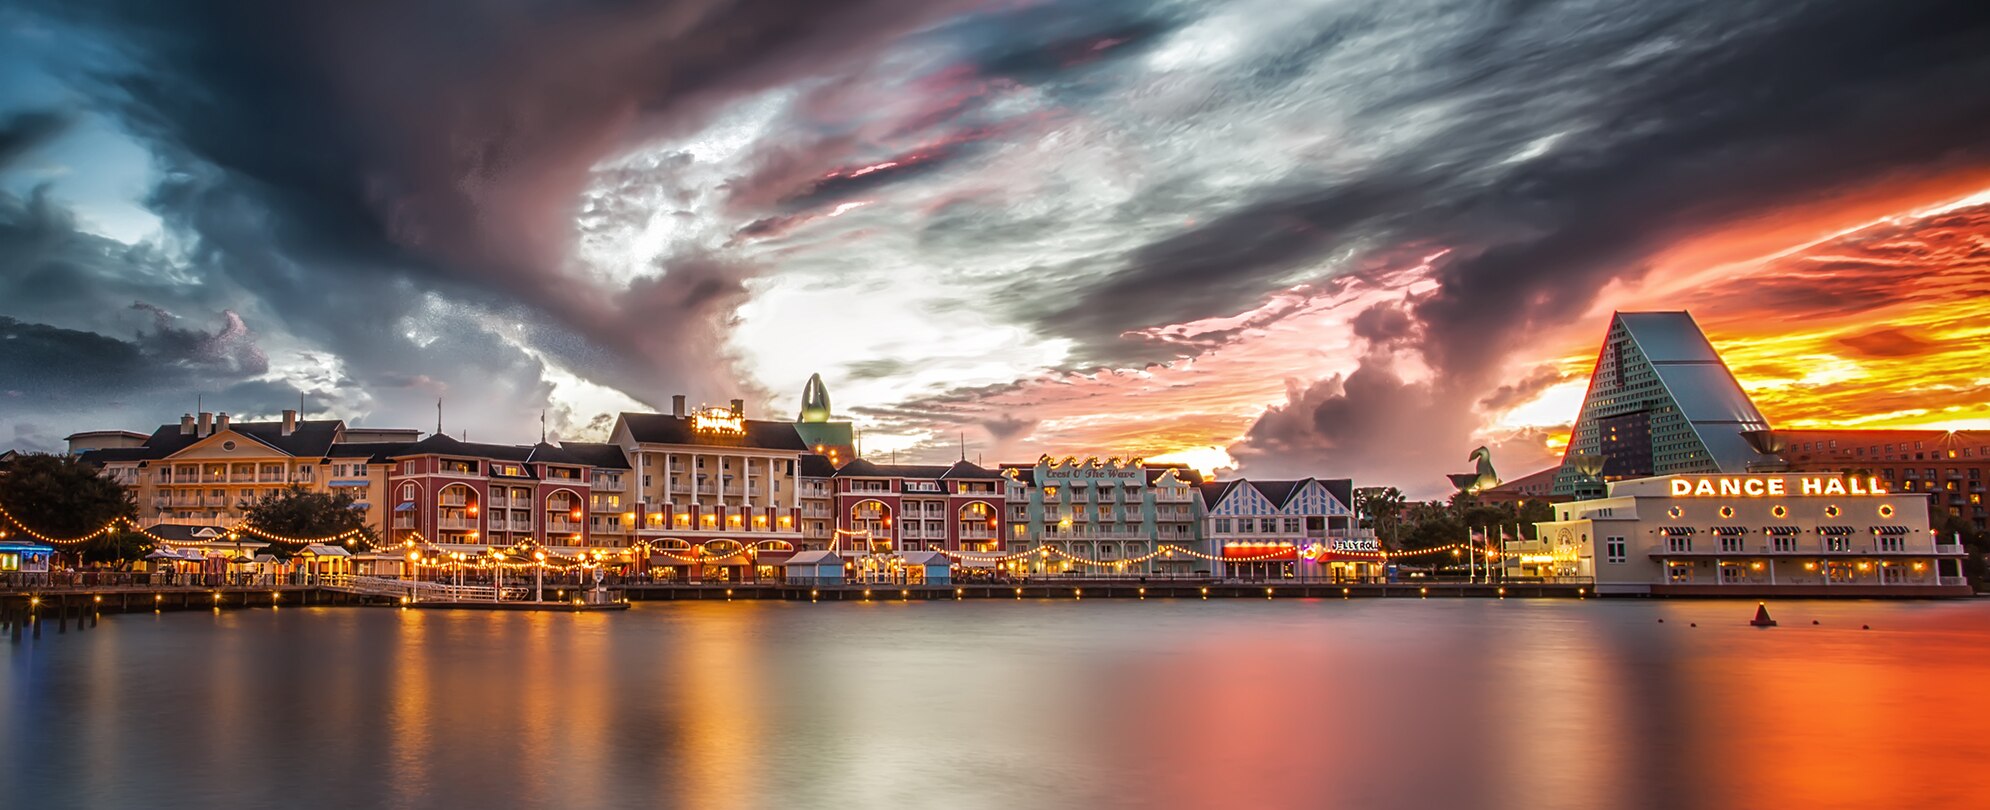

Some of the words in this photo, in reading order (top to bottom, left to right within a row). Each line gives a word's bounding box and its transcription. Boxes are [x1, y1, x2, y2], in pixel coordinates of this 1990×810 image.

[1085, 469, 1105, 478] The
[1107, 469, 1135, 478] Wave
[1671, 478, 1785, 496] DANCE
[1801, 476, 1887, 495] HALL
